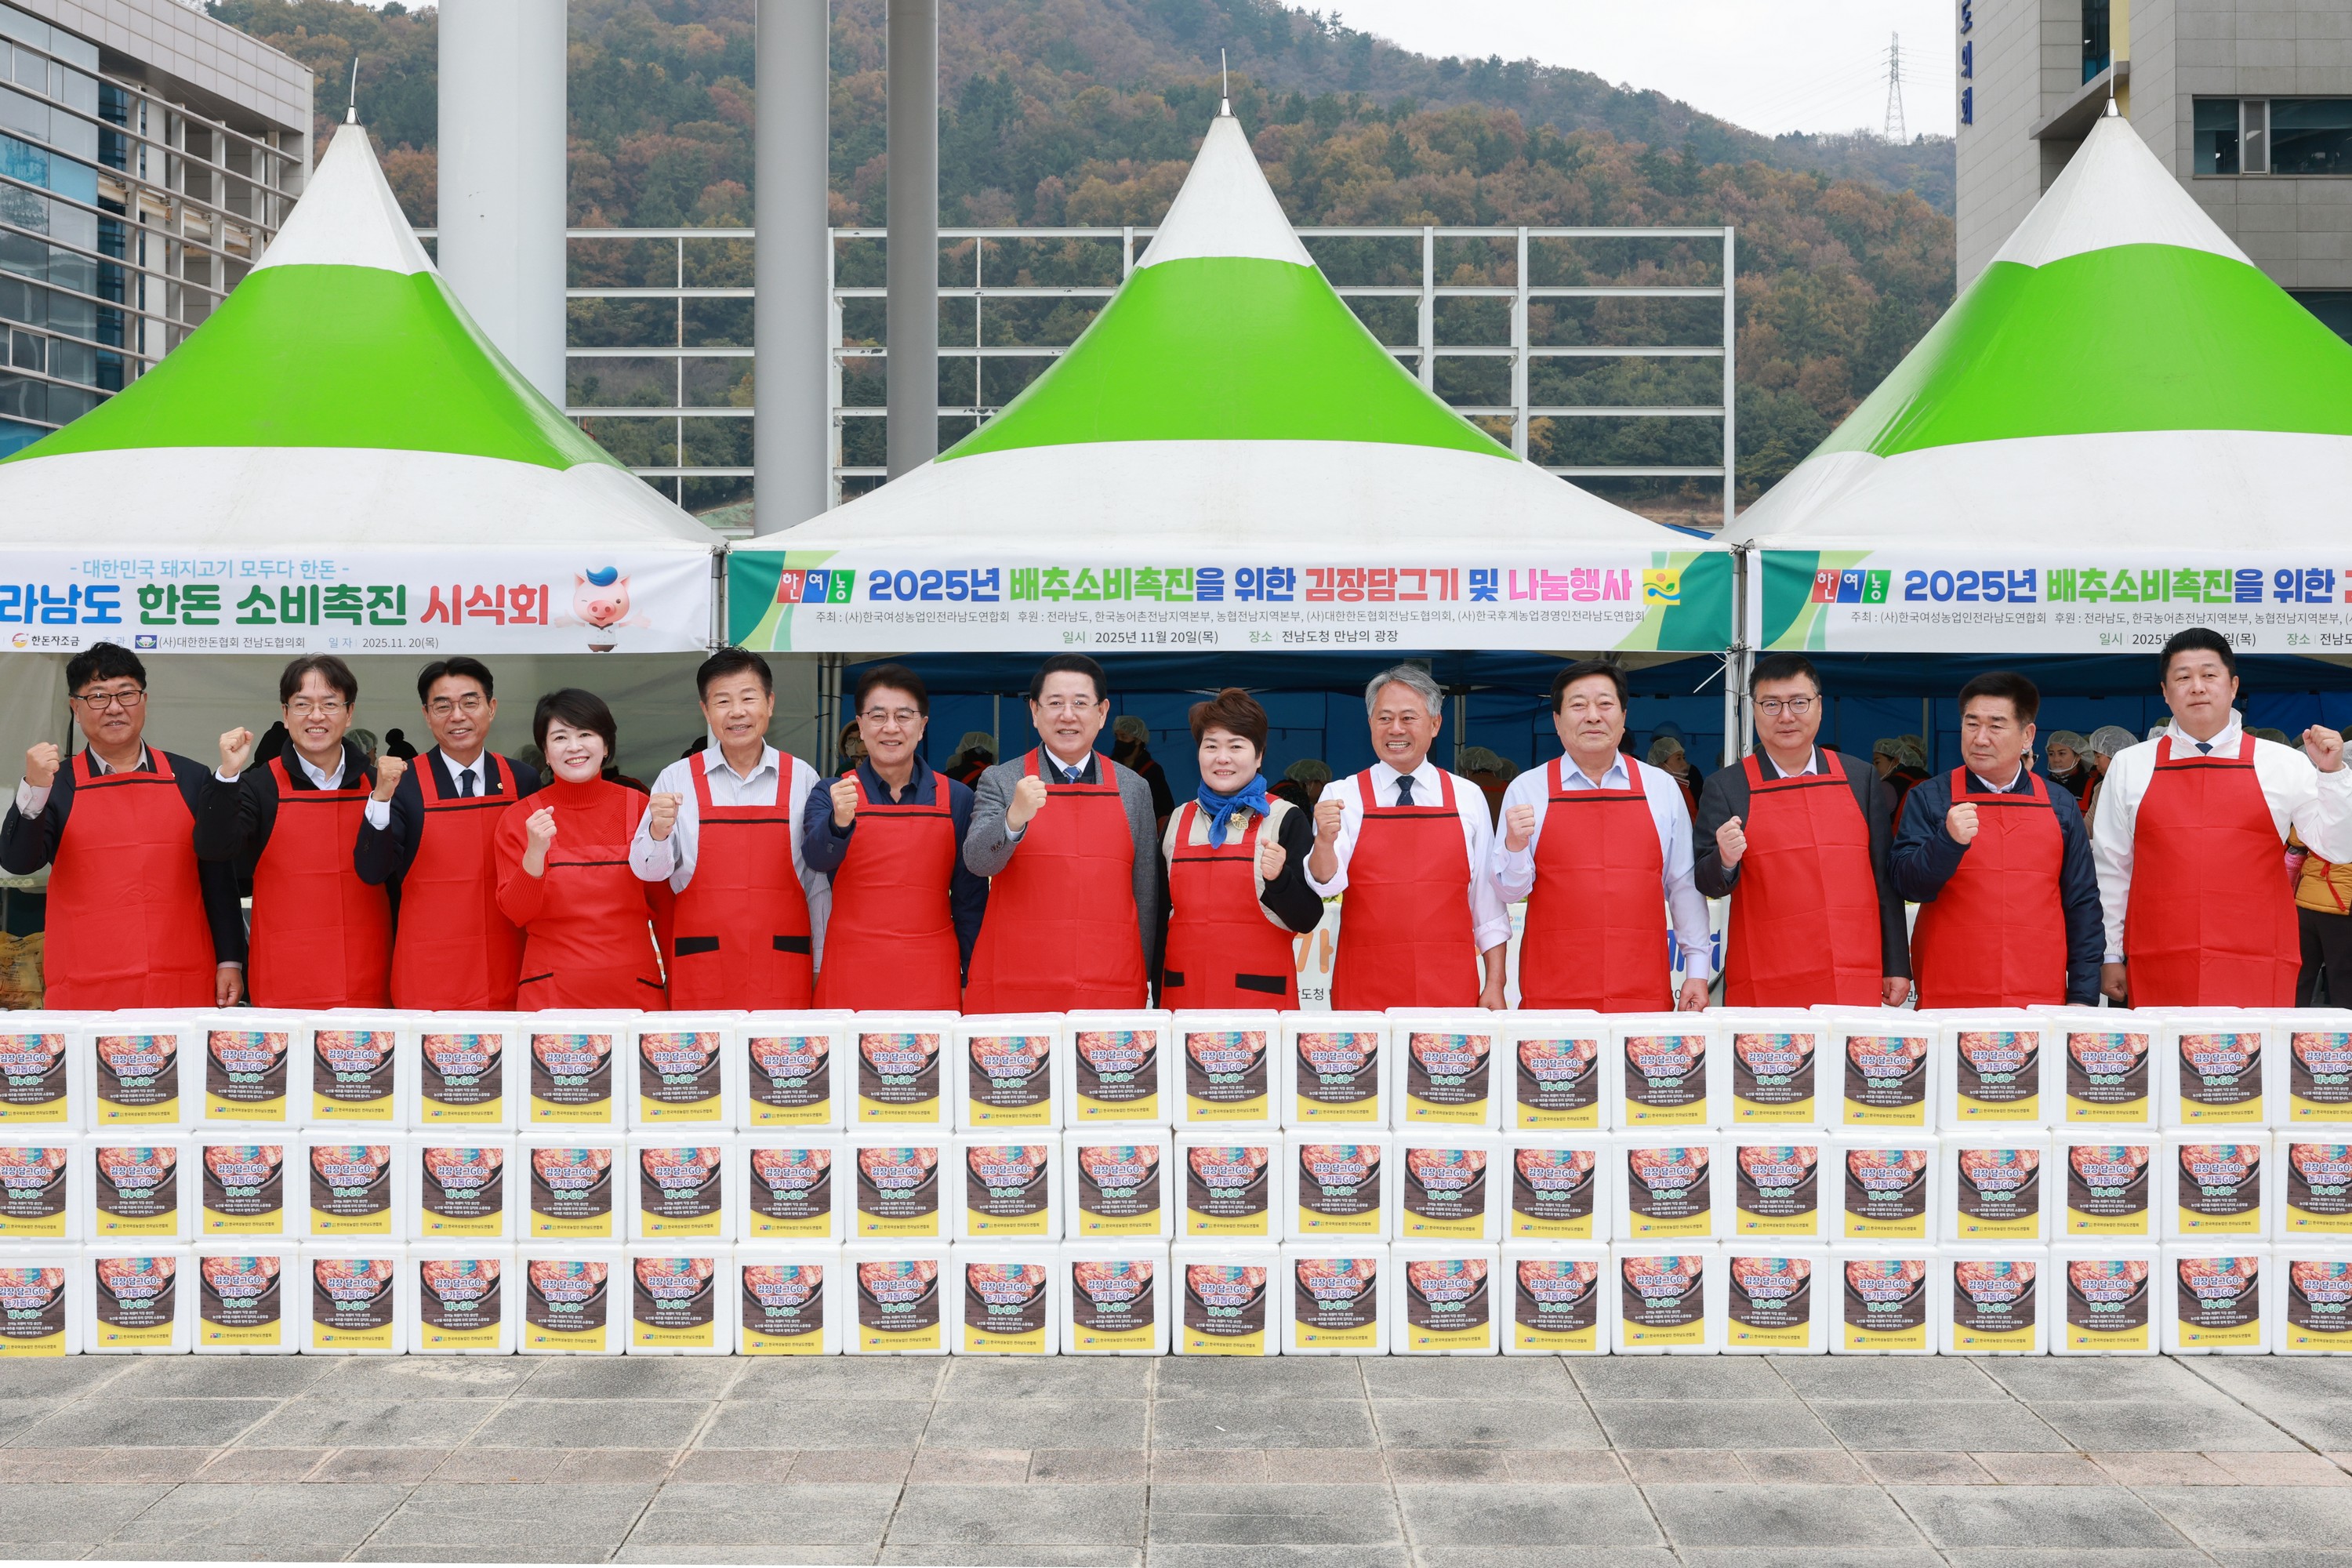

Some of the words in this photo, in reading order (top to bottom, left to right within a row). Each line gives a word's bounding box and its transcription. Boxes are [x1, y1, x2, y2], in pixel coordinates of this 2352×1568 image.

[83, 560, 154, 579] 대한민국
[161, 560, 232, 579] 돼지고기
[239, 560, 294, 579] 모두다
[300, 560, 336, 579] 한돈
[869, 568, 1000, 601] 2025년
[1011, 567, 1225, 601] 배추소비촉진을
[1235, 567, 1296, 601] 위한
[1306, 568, 1458, 602] 김장담그기
[1469, 568, 1498, 601] 및
[1509, 568, 1632, 601] 나눔행사
[1905, 569, 2036, 603] 2025년
[2047, 568, 2263, 603] 배추소비촉진을
[2274, 568, 2335, 603] 위한
[137, 584, 221, 625] 한돈
[236, 584, 407, 626] 소비촉진
[420, 584, 548, 626] 시식회
[816, 612, 835, 622] 주최
[1018, 612, 1037, 622] 후원
[1047, 612, 1091, 623] 전라남도,
[1851, 612, 1871, 622] 주최
[2055, 612, 2074, 623] 후원
[2085, 612, 2129, 625] 전라남도,
[32, 636, 80, 646] 한돈자조금
[1063, 631, 1085, 644] 일시
[1095, 631, 1136, 643] 2025년
[1142, 631, 1166, 643] 11월
[1171, 631, 1218, 644] 20일(목)
[1249, 631, 1272, 643] 장소
[1283, 630, 1329, 642] 전남도청
[1335, 630, 1369, 642] 만남의
[1375, 630, 1398, 642] 광장
[2100, 633, 2122, 645] 일시
[2287, 633, 2310, 645] 장소
[244, 637, 304, 648] 전남도협의회
[363, 638, 405, 648] 2025.11.
[409, 637, 438, 649] 20(목)
[111, 1055, 126, 1064] 김장
[437, 1054, 452, 1062] 김장
[1091, 1051, 1106, 1059] 김장
[1424, 1052, 1439, 1062] 김장
[1748, 1053, 1764, 1062] 김장
[2082, 1052, 2097, 1061] 김장
[764, 1056, 779, 1065] 김장
[872, 1167, 887, 1176] 김장
[1202, 1166, 1218, 1174] 김장
[1529, 1168, 1544, 1177] 김장
[1860, 1168, 1875, 1177] 김장
[2083, 1165, 2098, 1174] 김장
[328, 1279, 343, 1287] 김장
[648, 1277, 663, 1286] 김장
[1310, 1278, 1325, 1287] 김장
[1637, 1276, 1652, 1285] 김장
[1969, 1280, 1984, 1289] 김장
[980, 1282, 996, 1291] 김장
